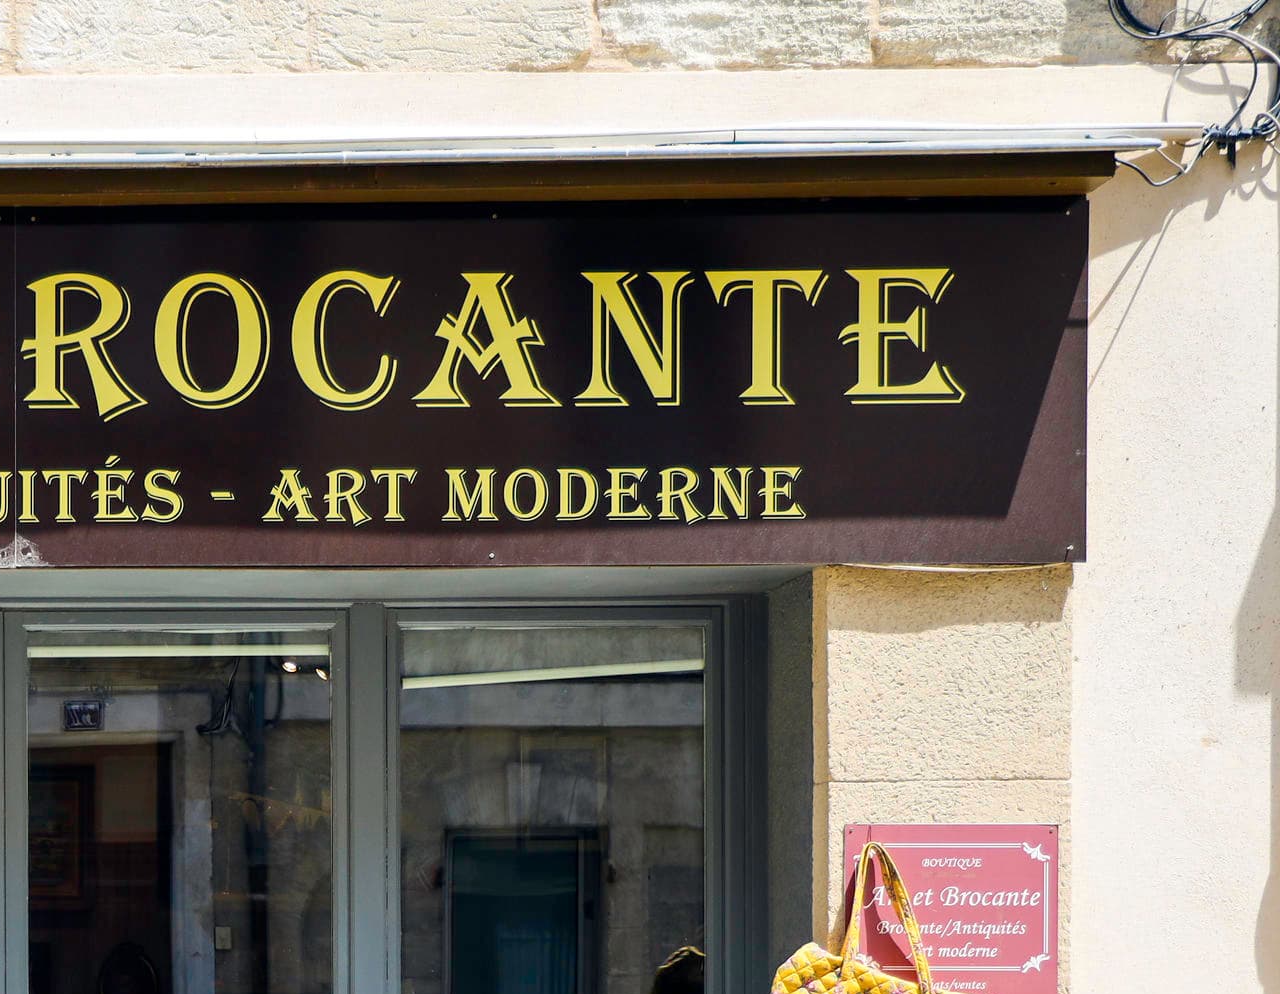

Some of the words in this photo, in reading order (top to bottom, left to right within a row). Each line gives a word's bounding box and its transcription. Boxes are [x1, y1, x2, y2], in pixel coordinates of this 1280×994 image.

[261, 468, 418, 528] ART
[441, 466, 807, 526] MODERNE
[922, 858, 983, 870] BOUTIQUE
[913, 889, 934, 907] et
[940, 886, 1041, 907] Brocante
[876, 919, 1027, 940] Bronte/Antiquités
[938, 942, 999, 958] moderne
[931, 979, 986, 991] ats/ventes
